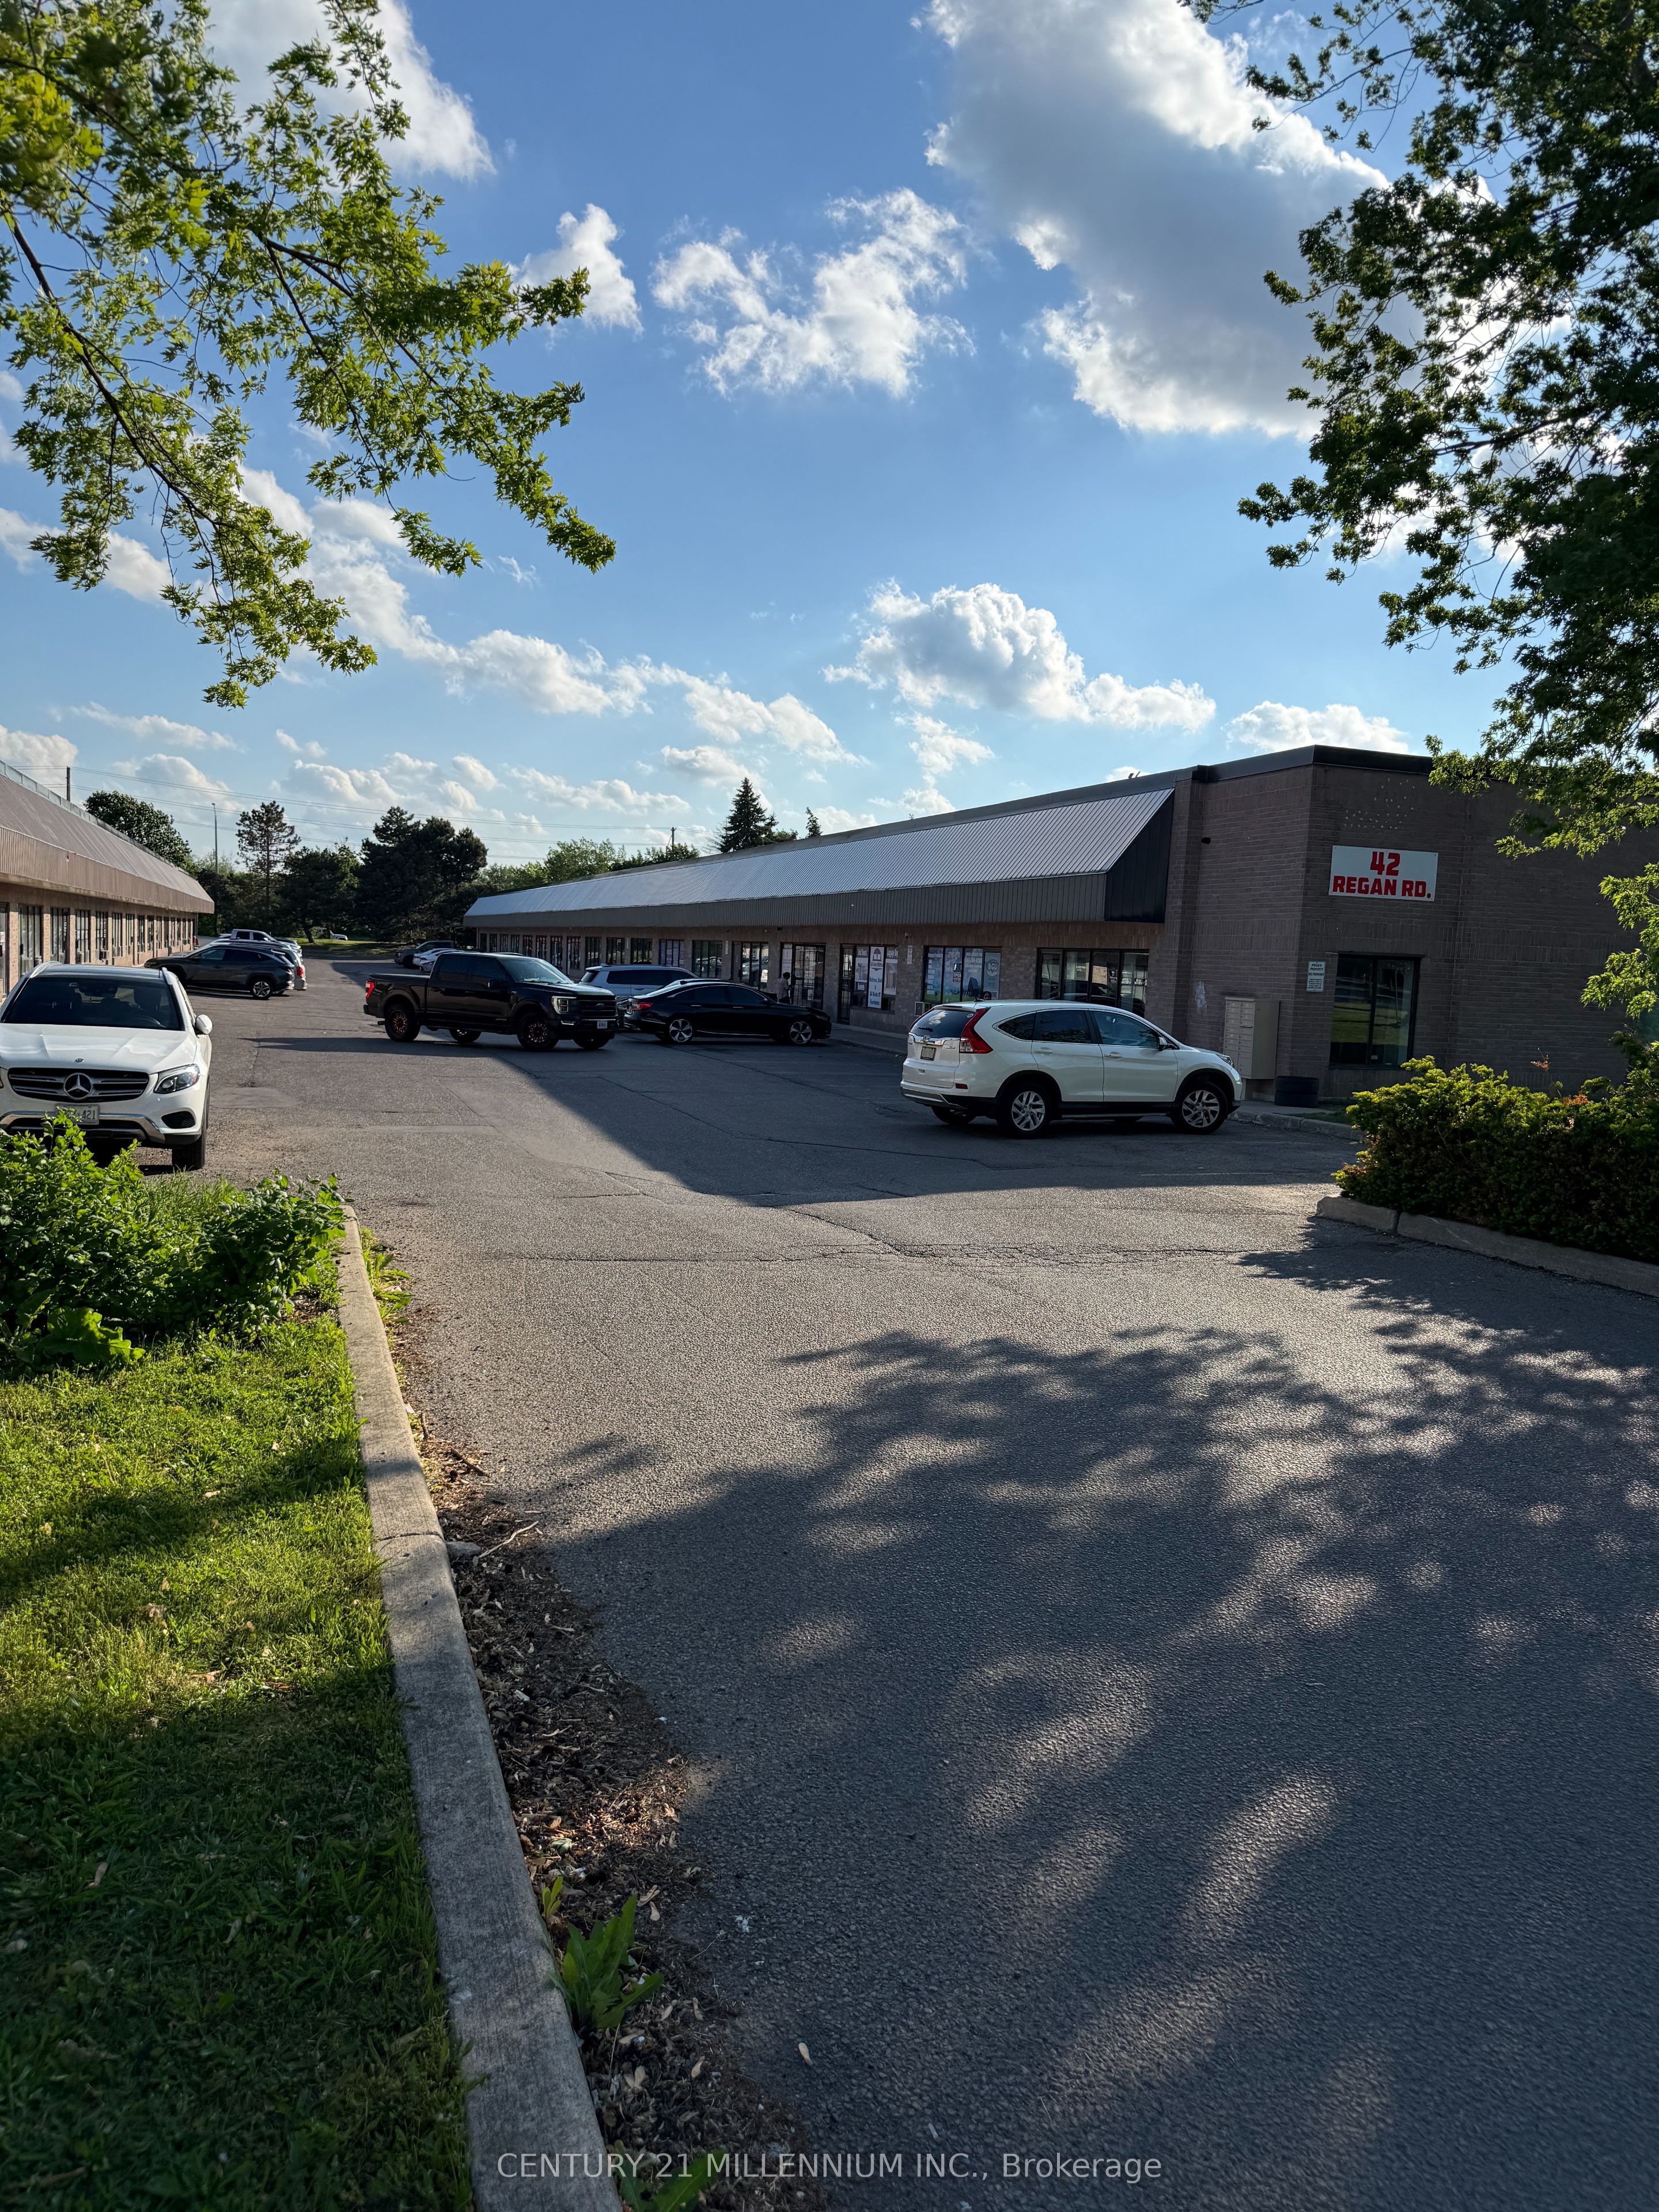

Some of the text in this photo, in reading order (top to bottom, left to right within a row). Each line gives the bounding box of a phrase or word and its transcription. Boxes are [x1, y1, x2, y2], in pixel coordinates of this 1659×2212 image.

[1370, 851, 1400, 876] 42
[1332, 876, 1431, 899] REGAN RD.
